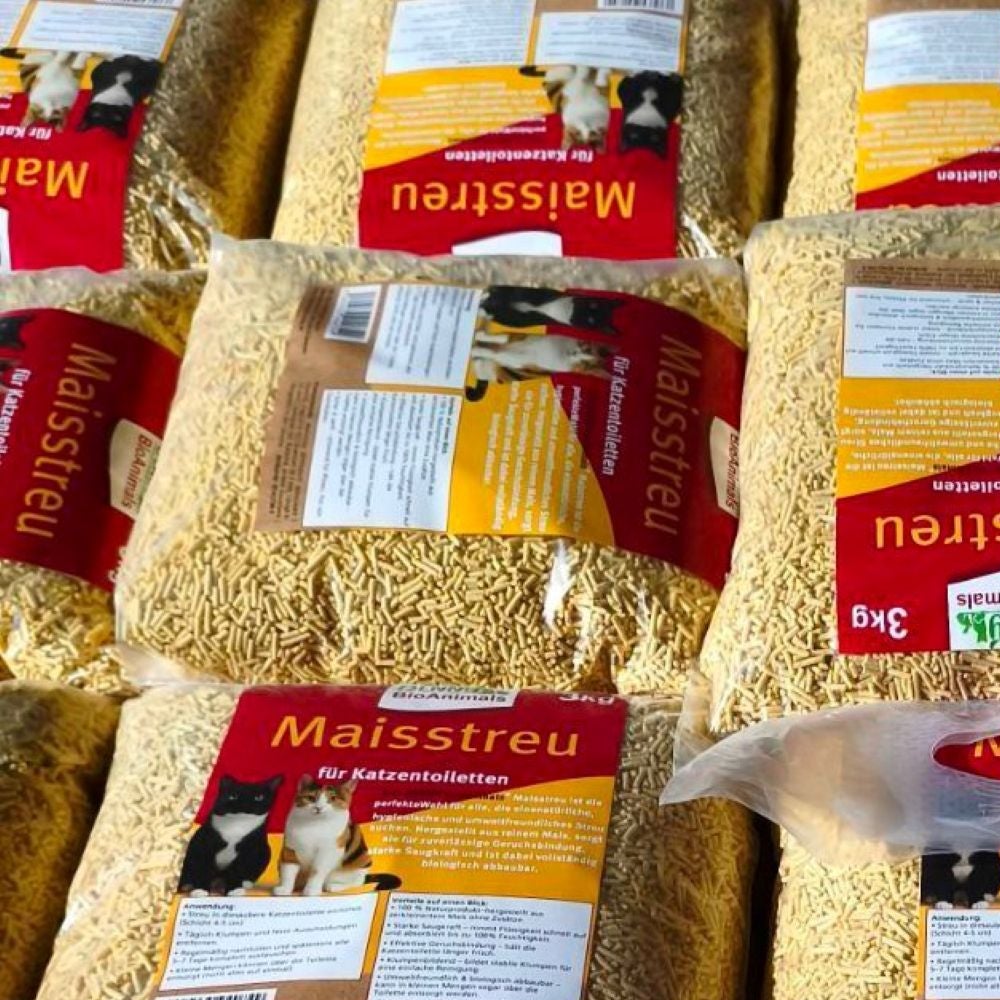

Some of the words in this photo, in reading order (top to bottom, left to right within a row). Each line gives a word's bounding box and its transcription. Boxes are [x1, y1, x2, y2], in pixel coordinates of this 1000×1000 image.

[445, 150, 566, 163] Katzentoiletten
[571, 150, 593, 162] für
[392, 181, 636, 221] Maisstreu
[610, 353, 630, 375] für
[16, 342, 118, 538] Maisstreu
[601, 377, 628, 476] Katzentoiletten
[642, 333, 702, 536] Maisstreu
[851, 604, 909, 639] 3kg
[271, 715, 580, 757] Maisstreu
[318, 766, 347, 780] für
[351, 767, 509, 786] Katzentoiletten
